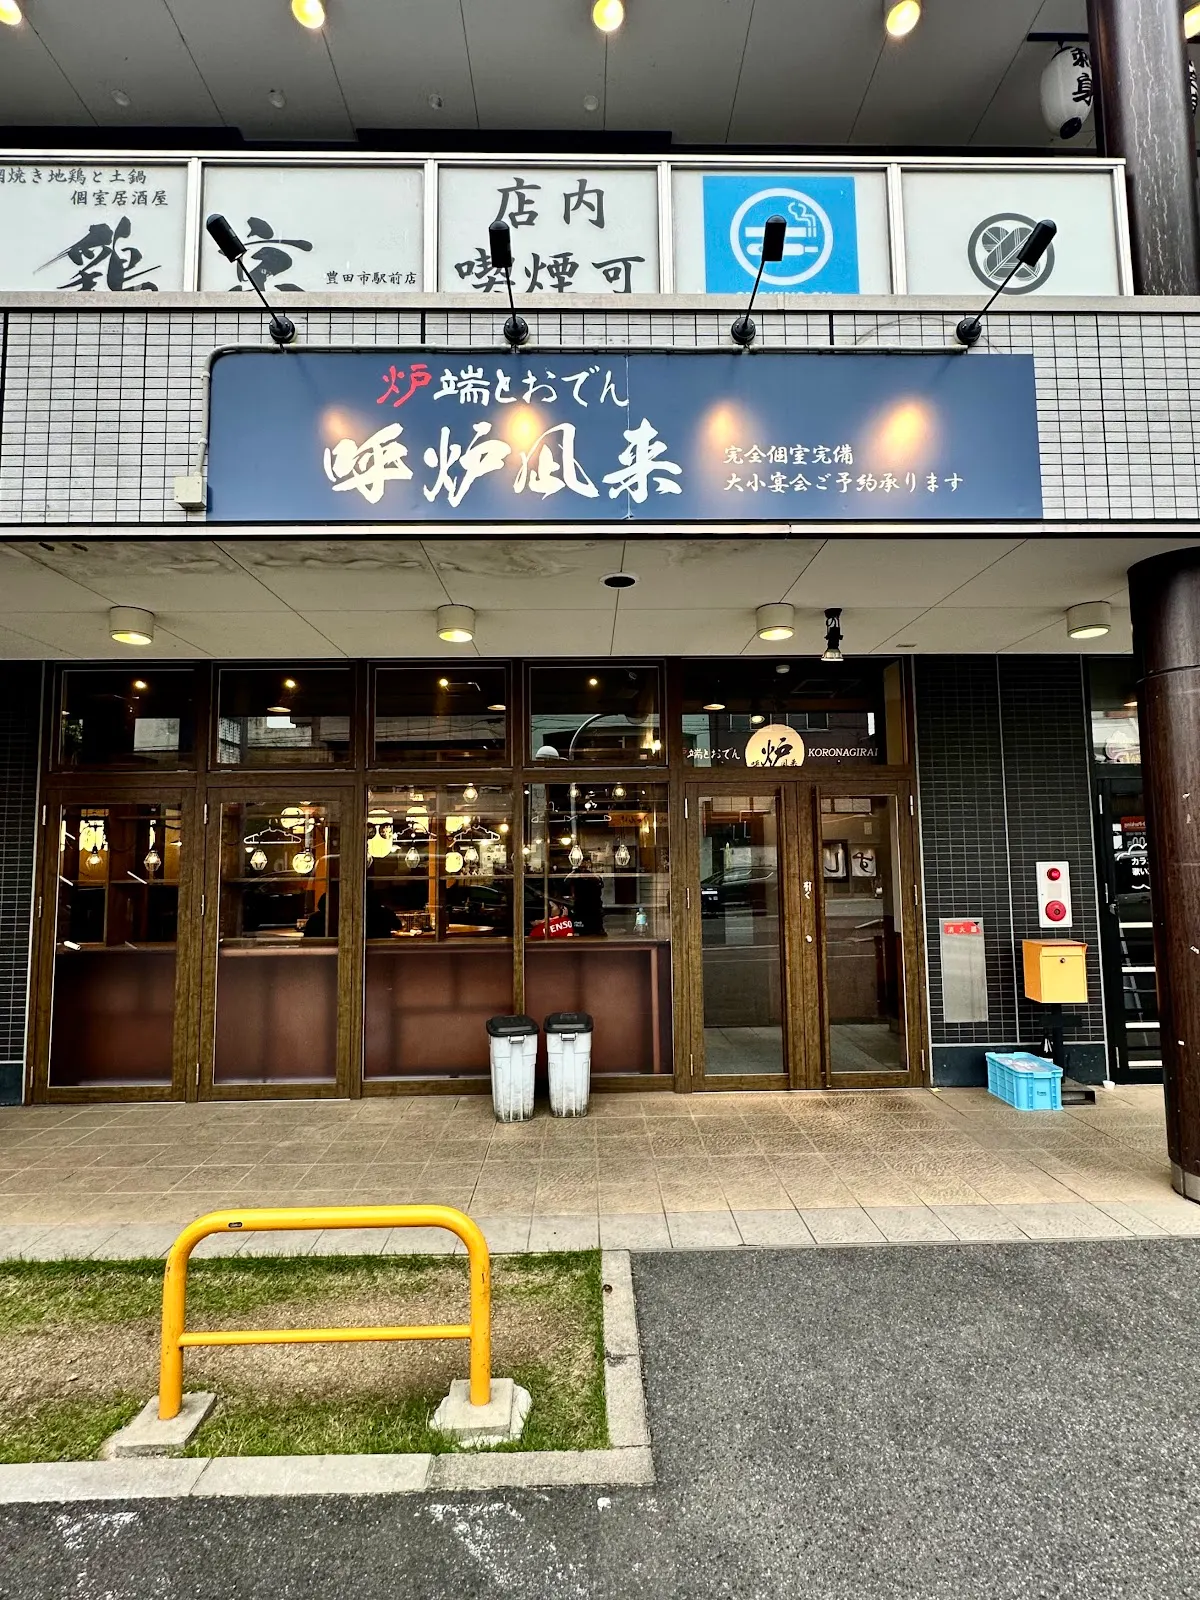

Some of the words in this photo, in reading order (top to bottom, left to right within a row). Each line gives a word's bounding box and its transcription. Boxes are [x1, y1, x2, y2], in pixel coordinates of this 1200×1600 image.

[0, 168, 147, 185] 焼き地鶏と土鍋
[70, 190, 169, 207] 個室居酒屋
[491, 177, 606, 229] 店内
[325, 270, 418, 285] 豊田市駅前店
[376, 363, 630, 408] 炉端とおでん
[723, 444, 854, 465] 完全個室完備
[723, 471, 964, 494] 大小宴会ご予約承ります
